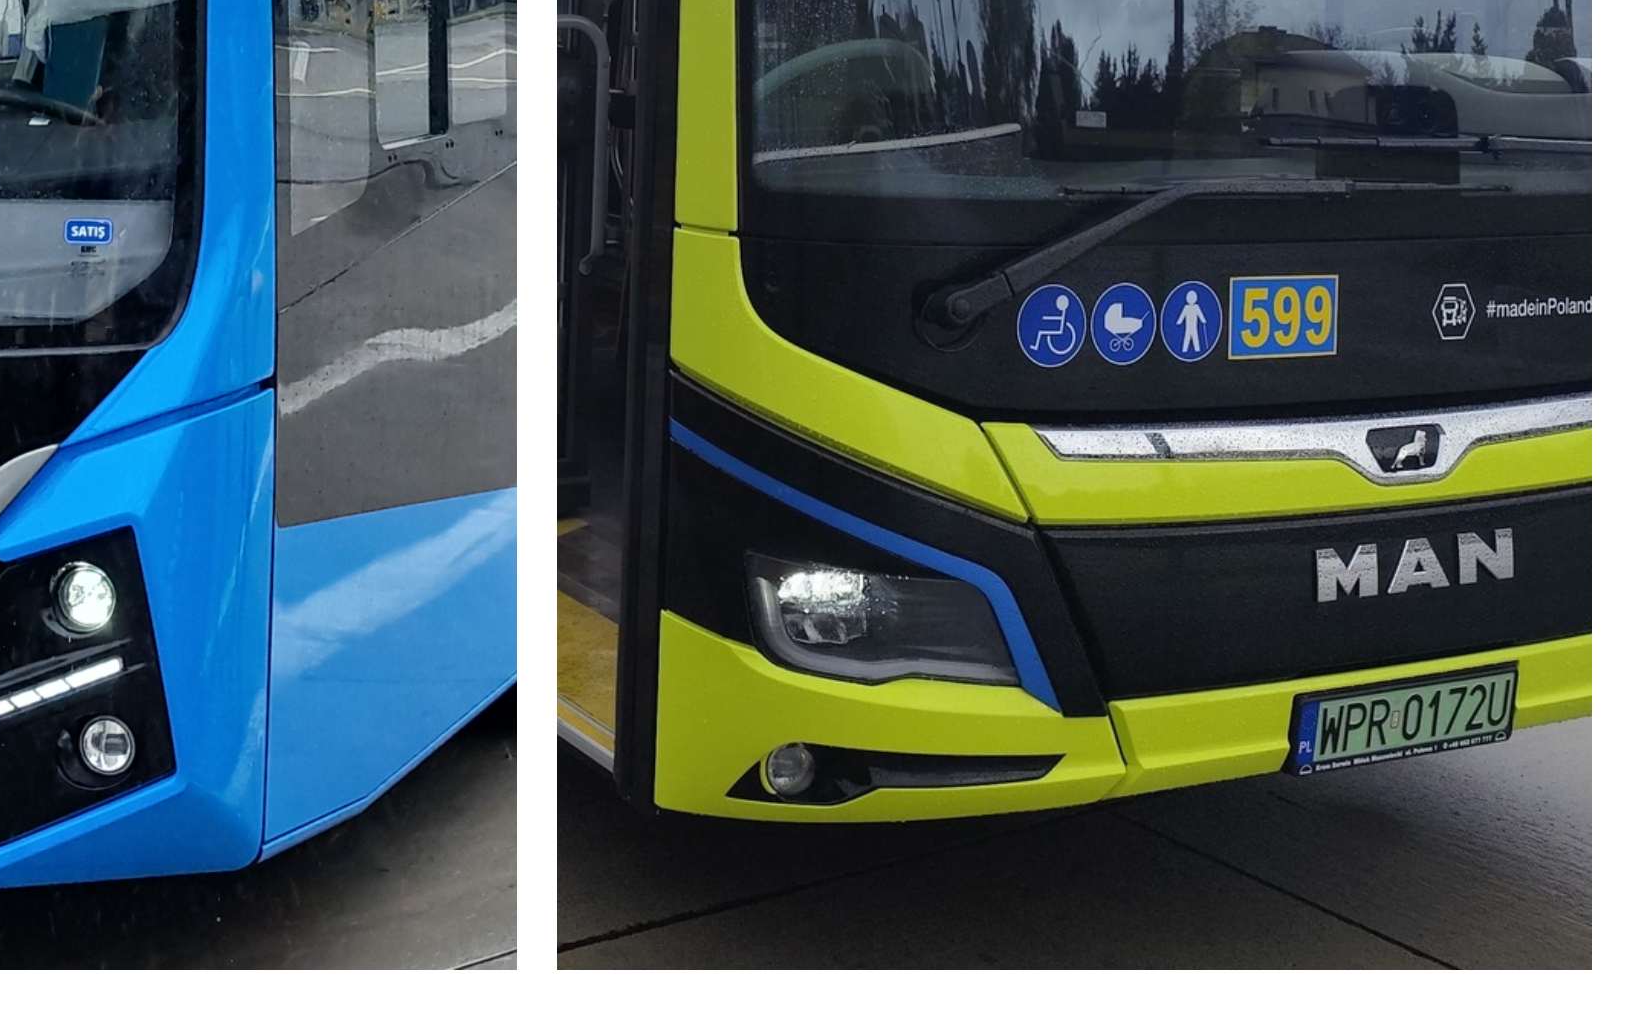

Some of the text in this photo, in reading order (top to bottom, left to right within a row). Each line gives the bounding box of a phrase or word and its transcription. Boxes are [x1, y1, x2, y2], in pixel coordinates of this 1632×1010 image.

[1241, 285, 1333, 348] 599
[1486, 296, 1592, 318] #madeinPoland
[1315, 527, 1515, 603] MAN
[1298, 680, 1511, 756] PL WPR 0172U
